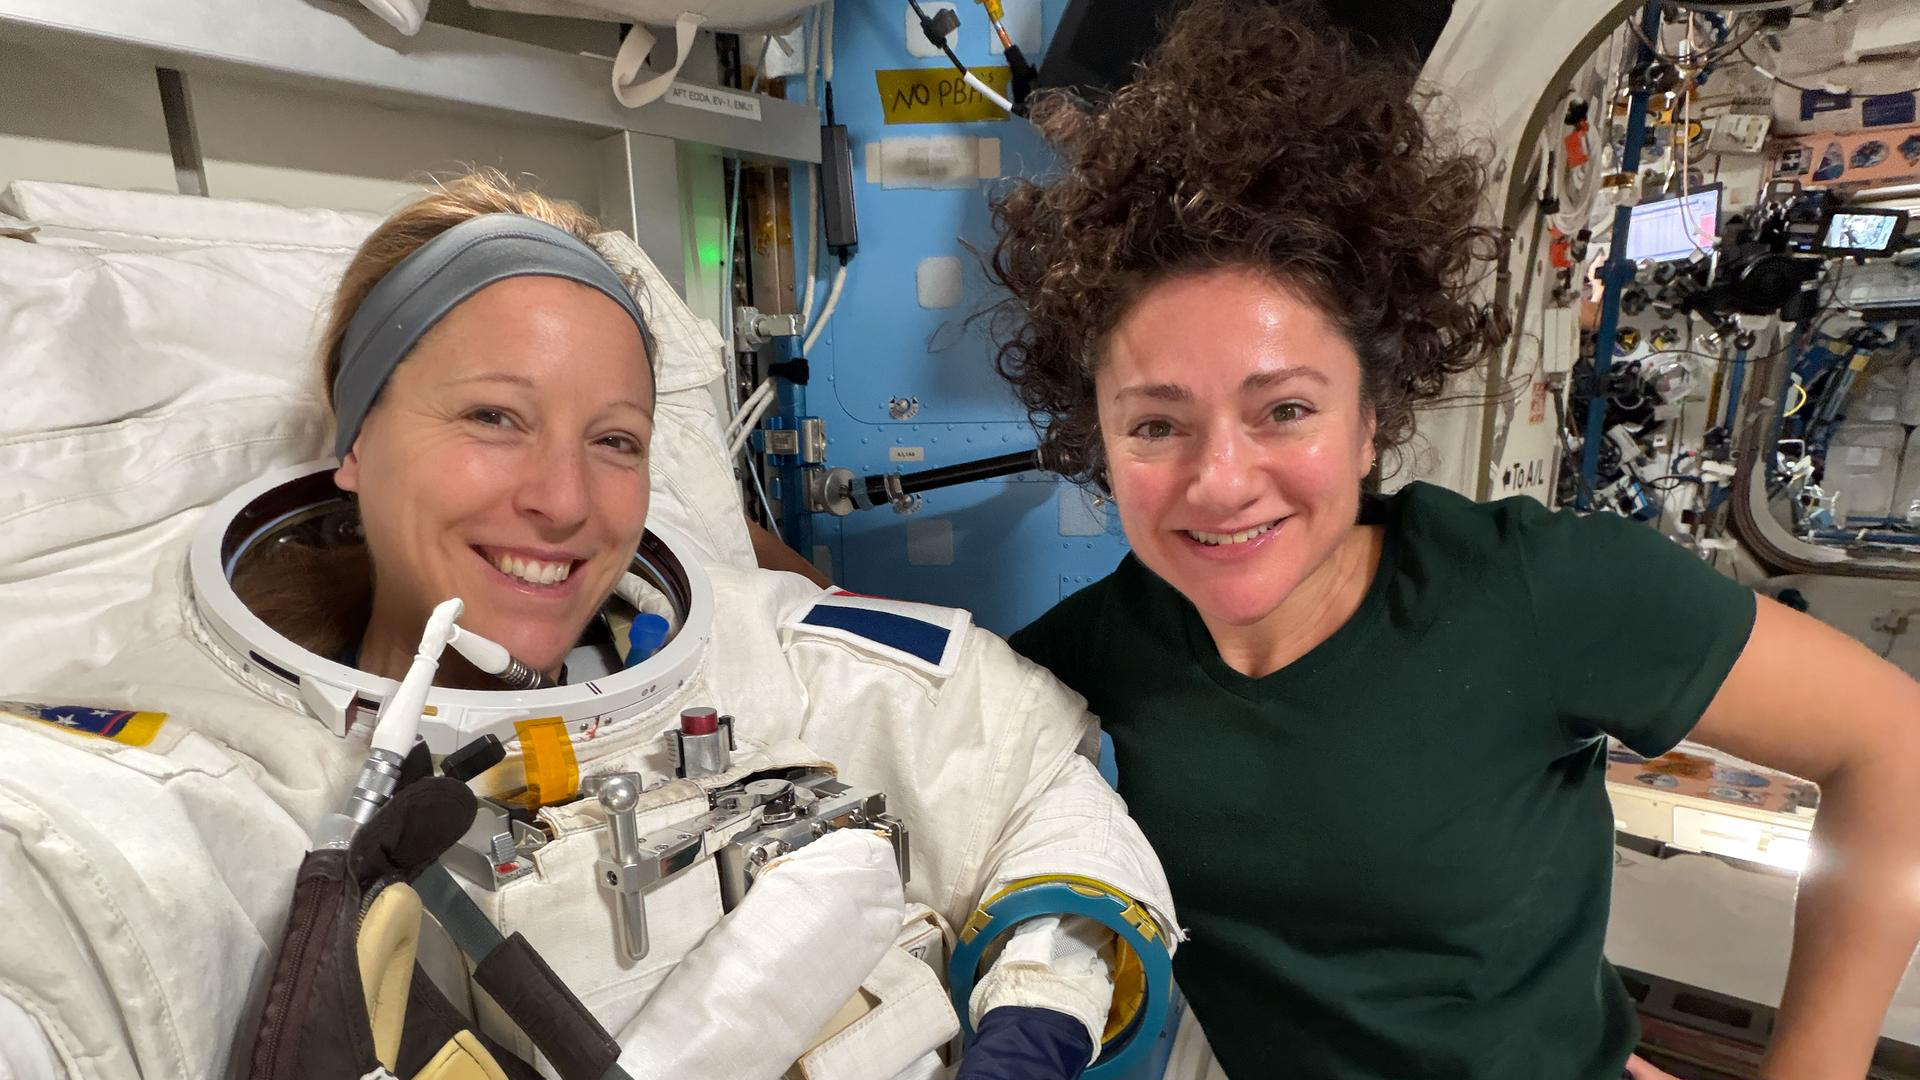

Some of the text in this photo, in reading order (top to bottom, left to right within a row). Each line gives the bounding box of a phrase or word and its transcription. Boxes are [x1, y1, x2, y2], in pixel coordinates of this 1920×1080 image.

[672, 87, 686, 98] AFT
[892, 81, 930, 112] NO
[1513, 459, 1544, 490] To A/L
